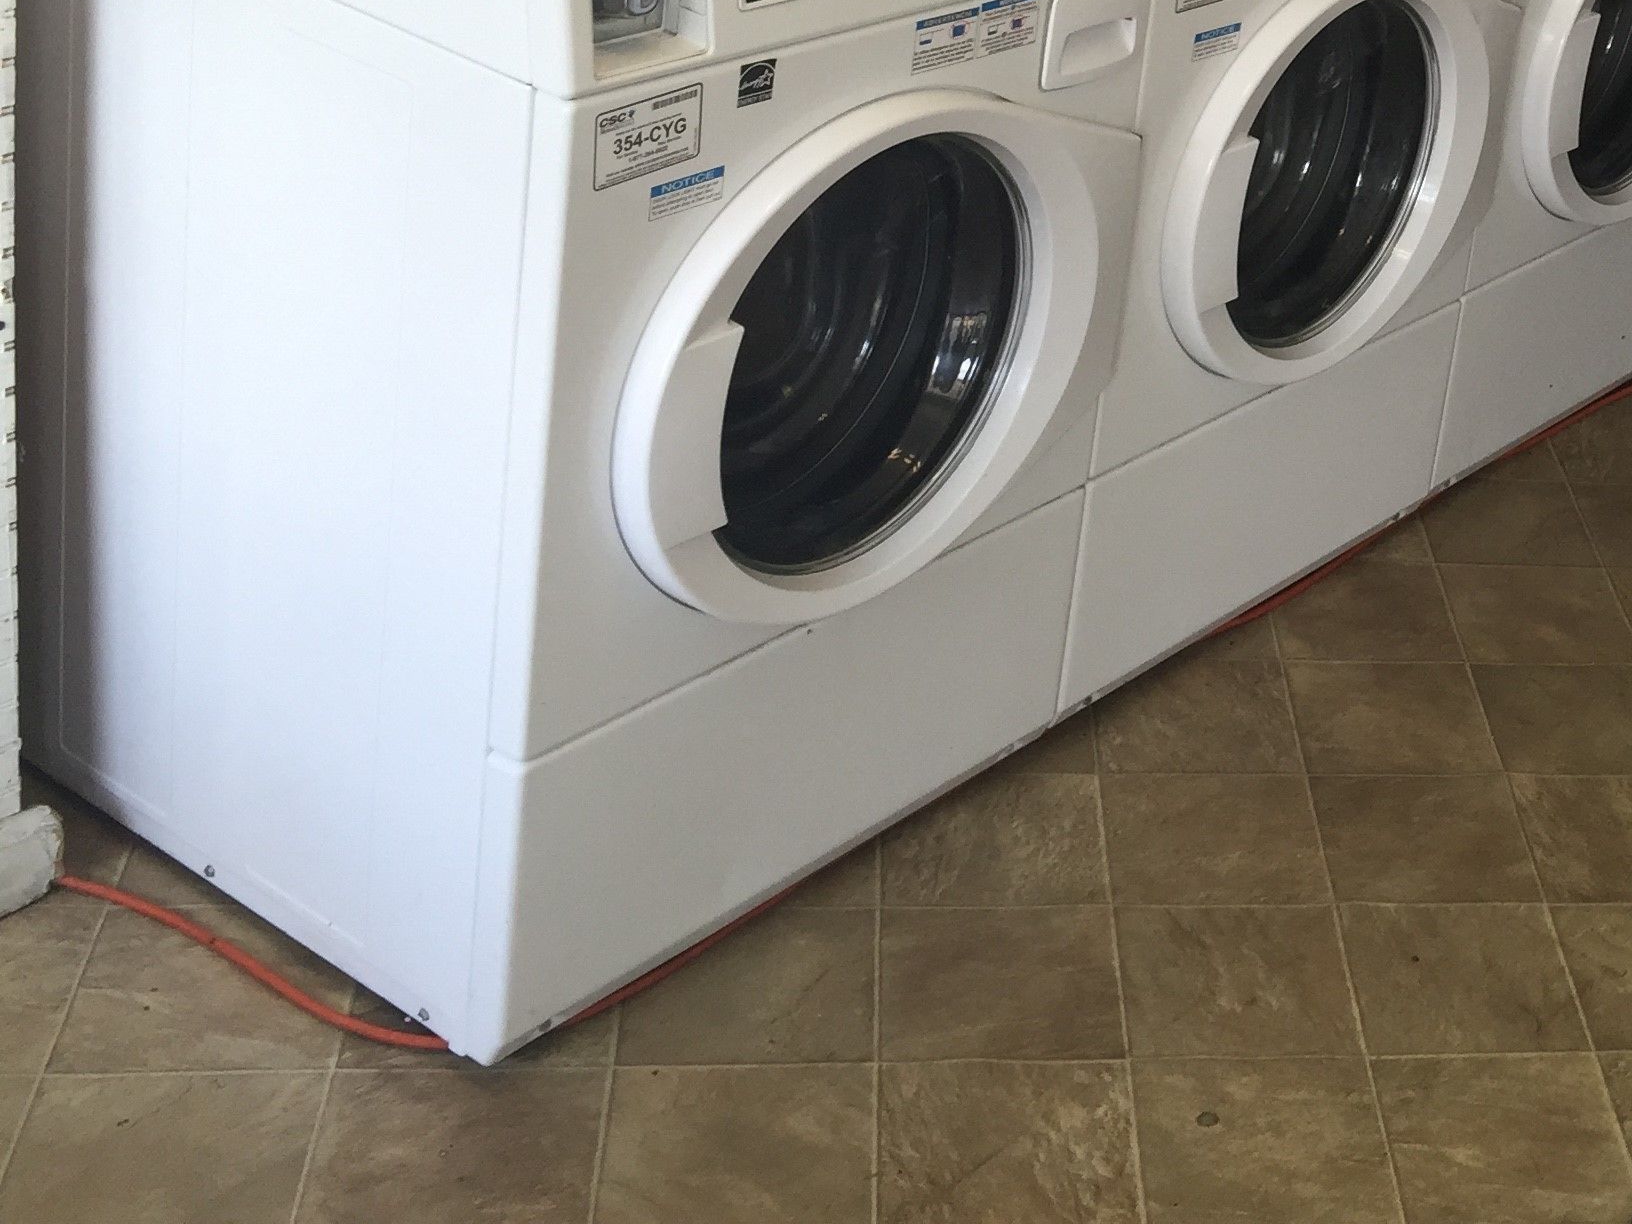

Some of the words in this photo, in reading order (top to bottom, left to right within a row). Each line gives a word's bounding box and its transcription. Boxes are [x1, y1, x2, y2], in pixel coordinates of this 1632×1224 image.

[599, 112, 627, 128] CSC
[612, 117, 687, 156] 354-CYG
[661, 169, 716, 193] NOTICE
